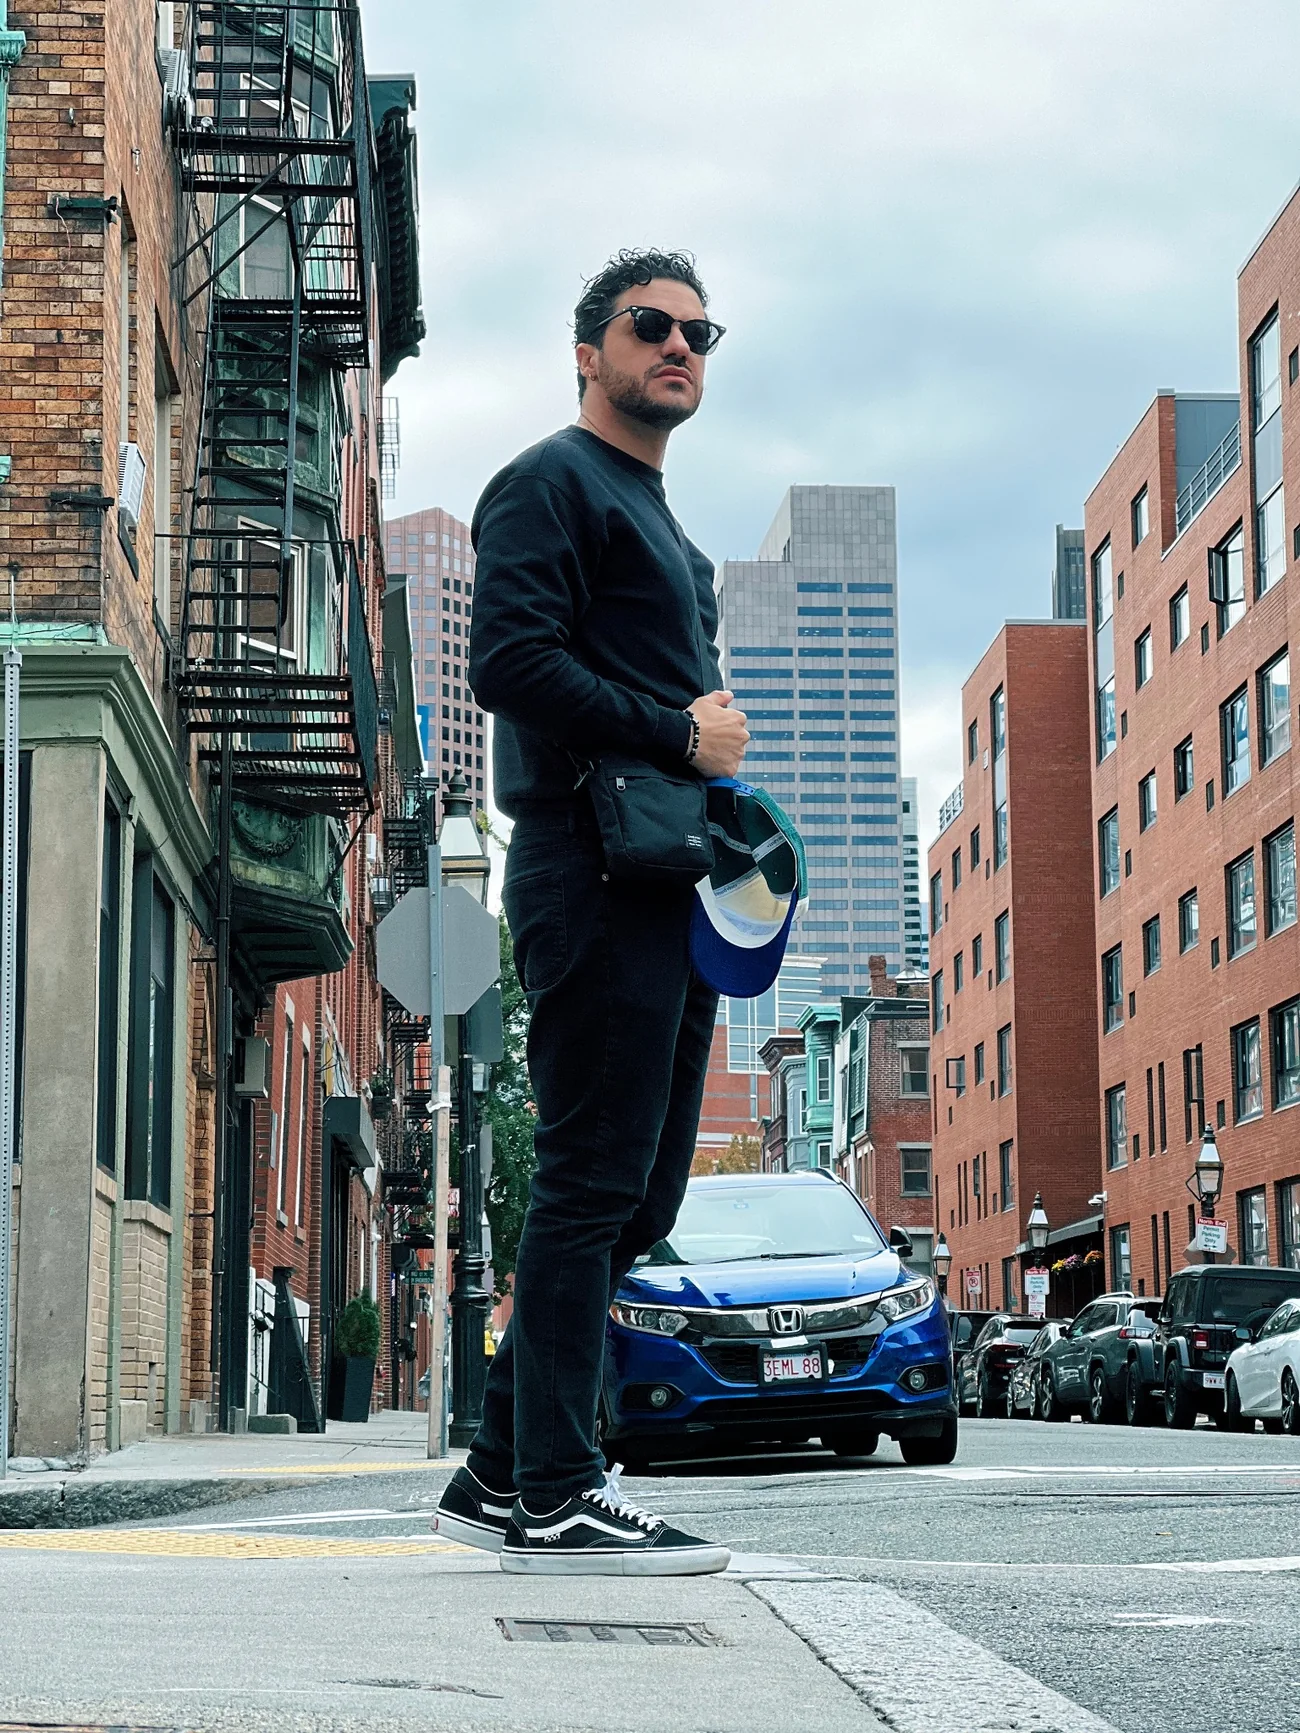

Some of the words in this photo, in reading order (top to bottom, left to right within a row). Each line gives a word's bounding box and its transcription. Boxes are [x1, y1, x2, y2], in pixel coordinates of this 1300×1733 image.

[1202, 1231, 1220, 1239] Parking
[764, 1359, 799, 1376] 3EML
[803, 1358, 820, 1374] 88
